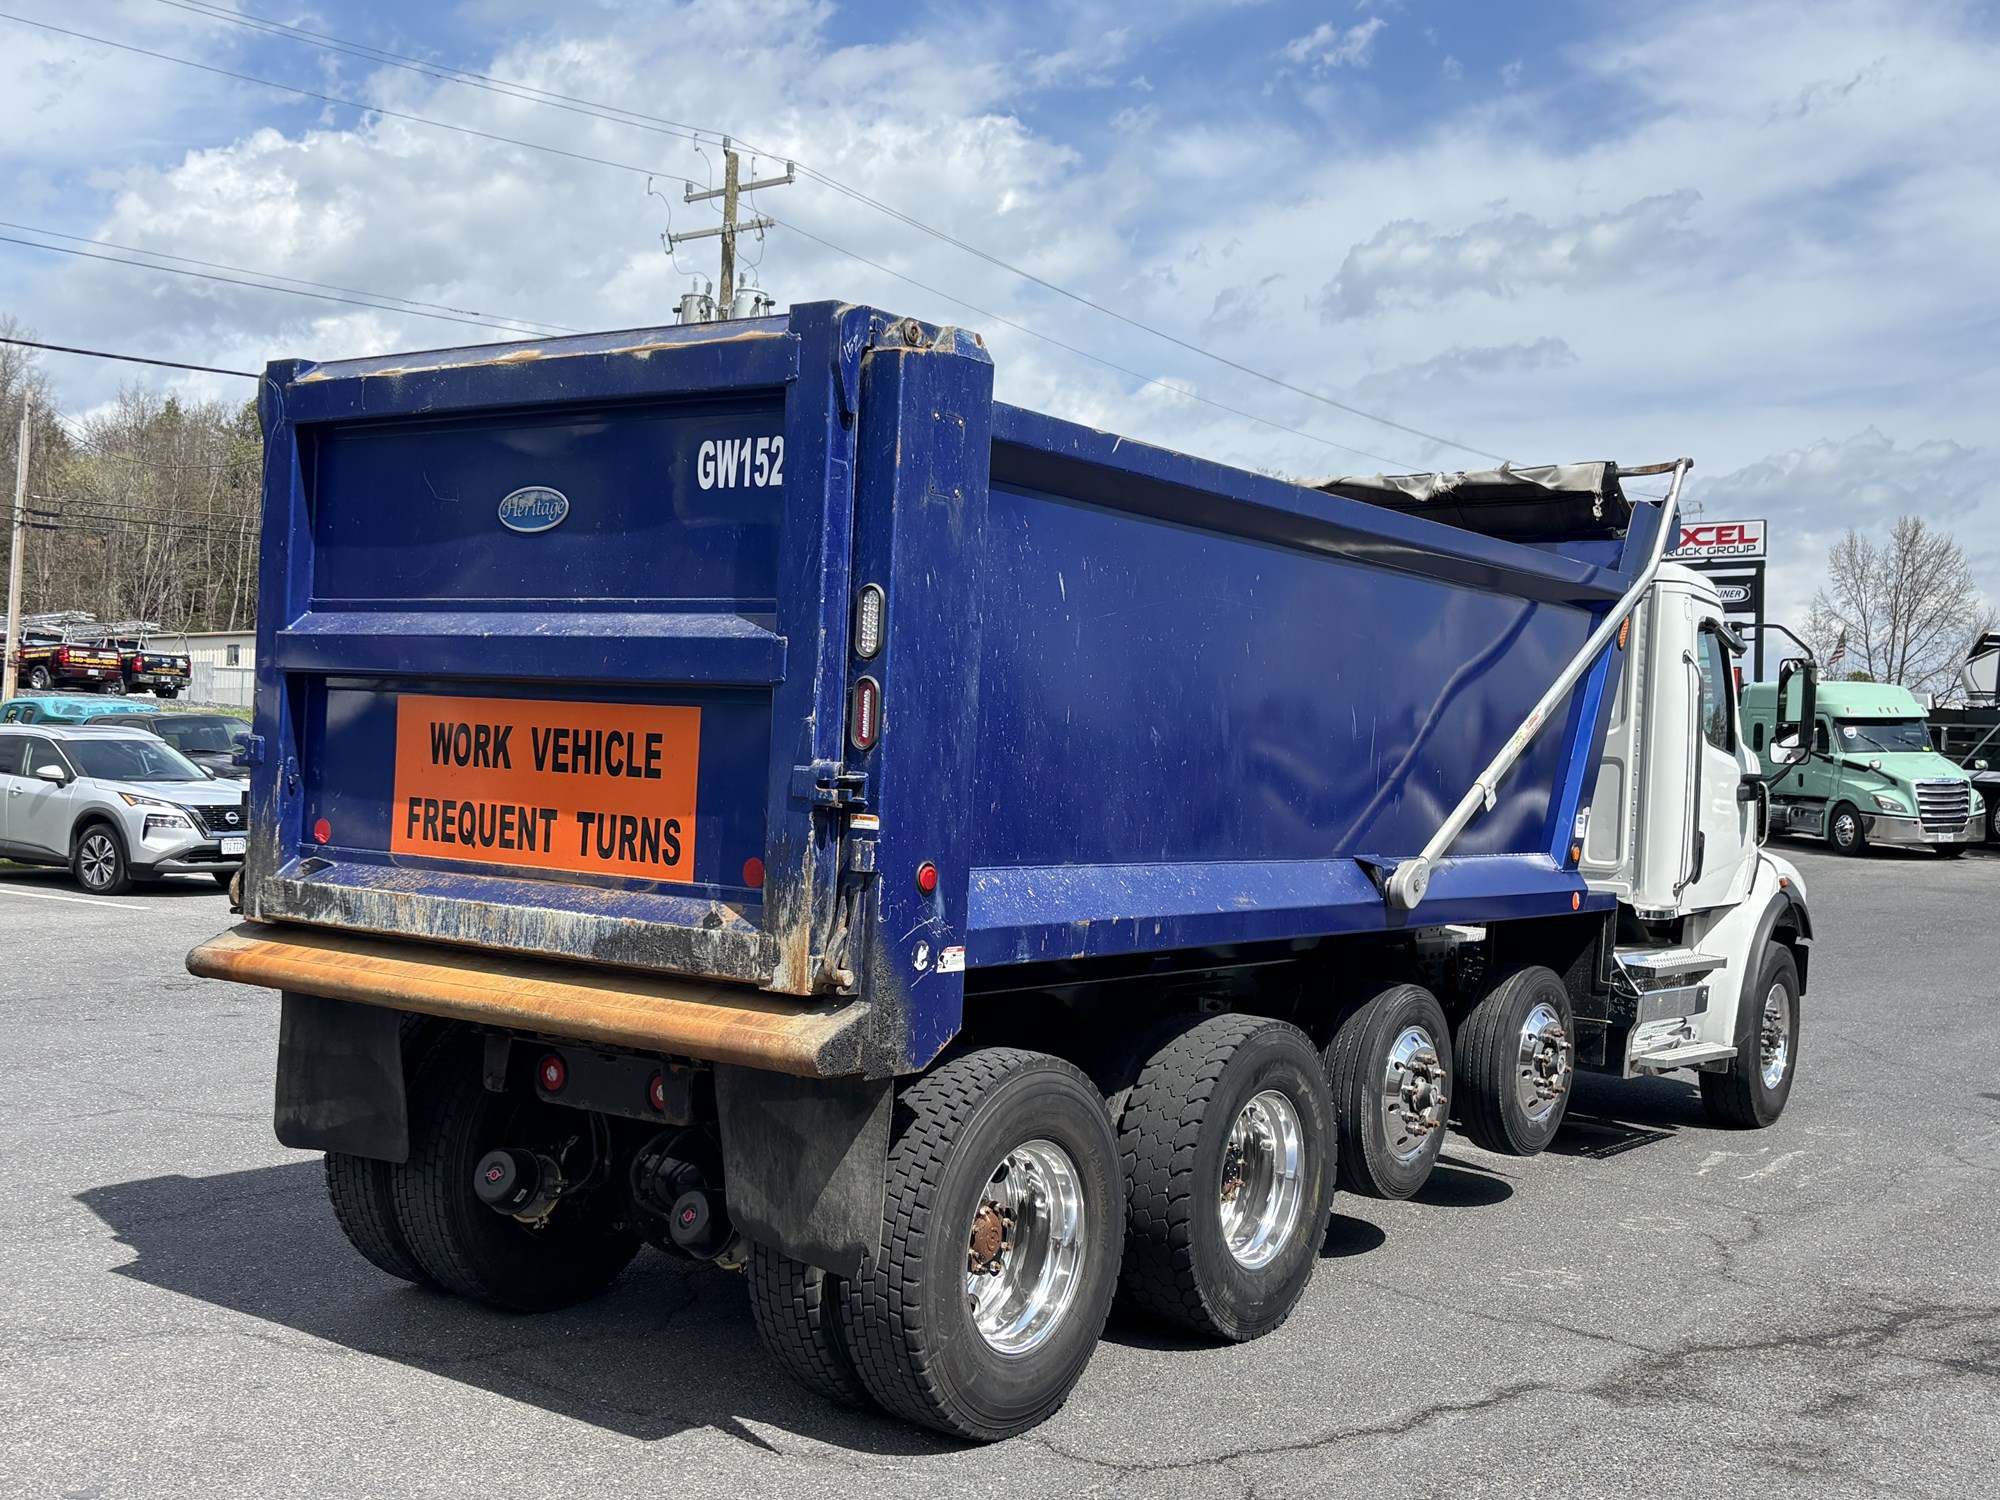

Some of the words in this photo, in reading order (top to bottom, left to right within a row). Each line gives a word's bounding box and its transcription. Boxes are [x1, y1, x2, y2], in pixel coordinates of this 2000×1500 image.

[697, 435, 785, 491] GW152
[502, 494, 565, 521] Heritage
[1680, 525, 1759, 546] XCEL
[1665, 547, 1702, 557] RUCK
[1706, 544, 1757, 556] GROUP
[1718, 589, 1742, 599] INER
[430, 722, 514, 770] WORK
[531, 726, 664, 780] VEHICLE
[406, 796, 559, 854] FREQUENT
[576, 811, 682, 867] TURNS
